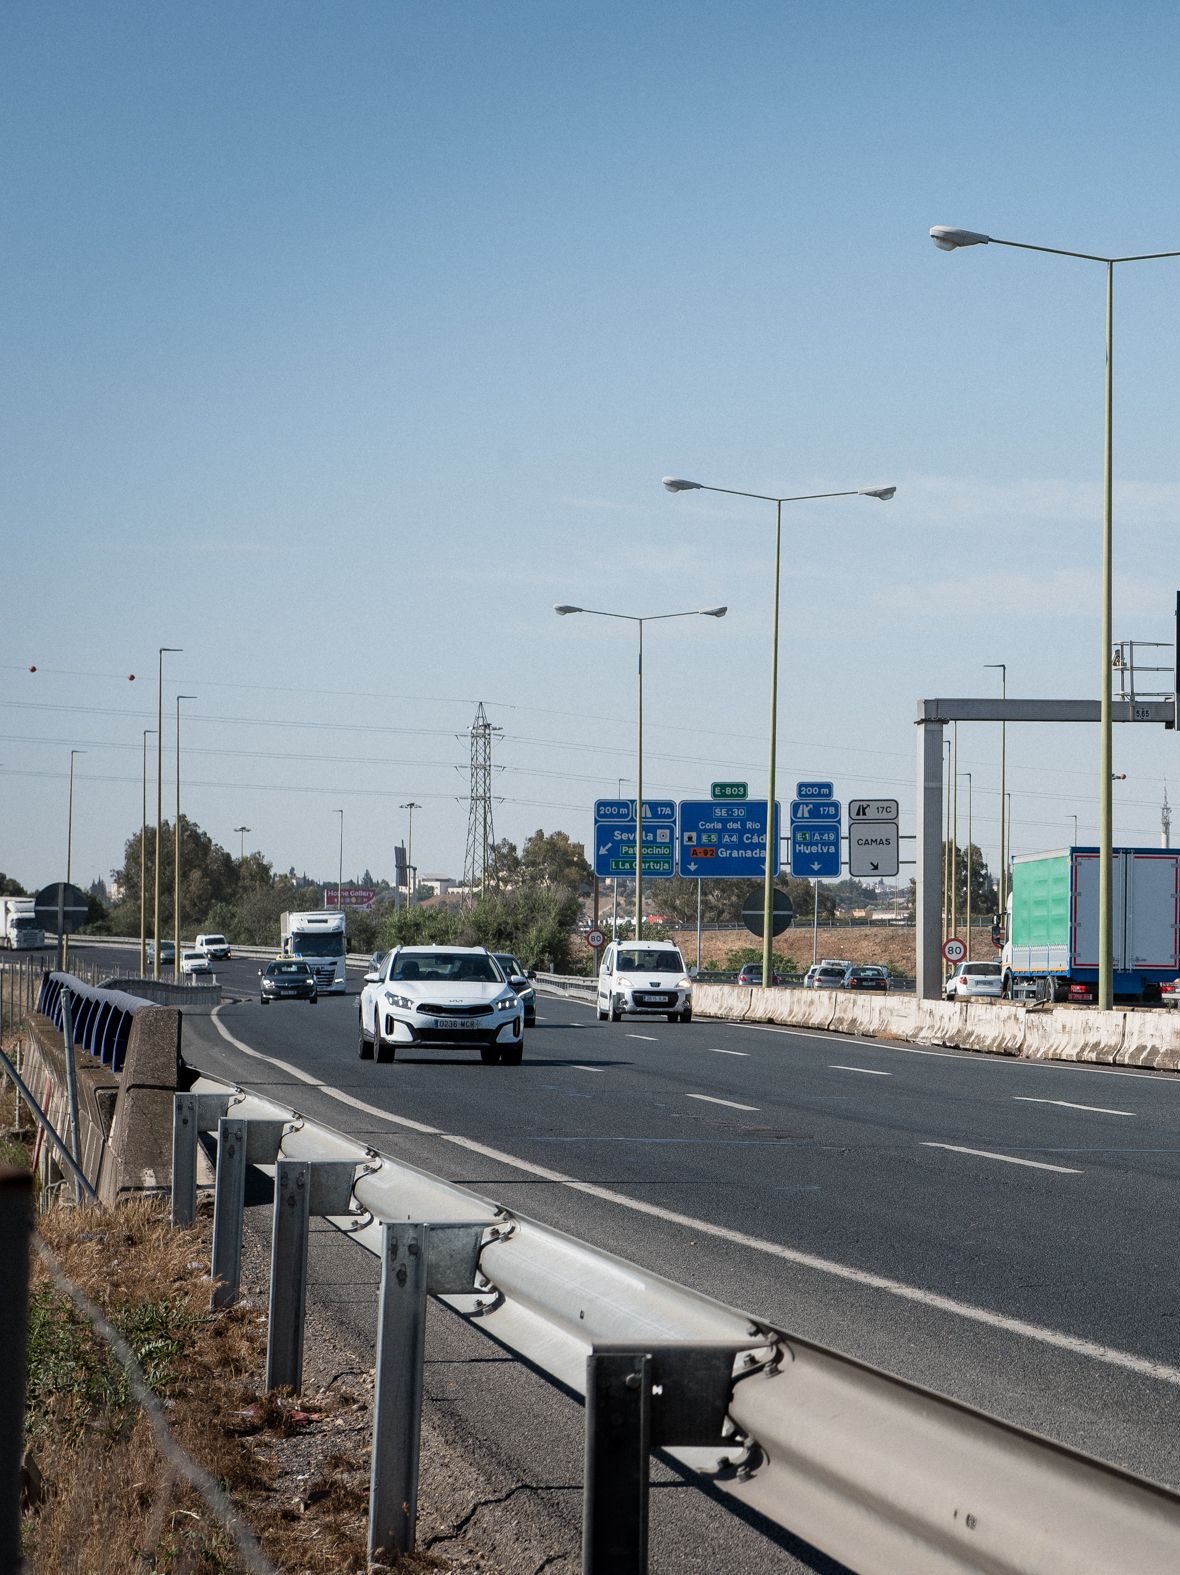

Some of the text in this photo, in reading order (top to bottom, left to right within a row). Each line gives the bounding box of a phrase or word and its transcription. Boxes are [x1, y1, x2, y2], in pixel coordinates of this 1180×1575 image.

[715, 787, 744, 795] E-803
[801, 787, 819, 795] 200
[599, 806, 618, 815] 200
[657, 807, 672, 815] 17A
[714, 808, 745, 816] SE-30
[819, 807, 835, 815] 17B
[876, 806, 892, 814] 17C
[699, 821, 722, 829] Coria
[727, 821, 741, 829] del
[613, 830, 653, 840] Sevla
[743, 833, 766, 843] Cád
[813, 833, 835, 841] A-49
[857, 838, 891, 846] CAMAS
[622, 846, 669, 854] Patocinio
[718, 848, 767, 857] Granada
[796, 844, 835, 853] Huelva
[691, 849, 715, 857] A-92
[619, 861, 630, 869] La
[947, 946, 962, 955] 80
